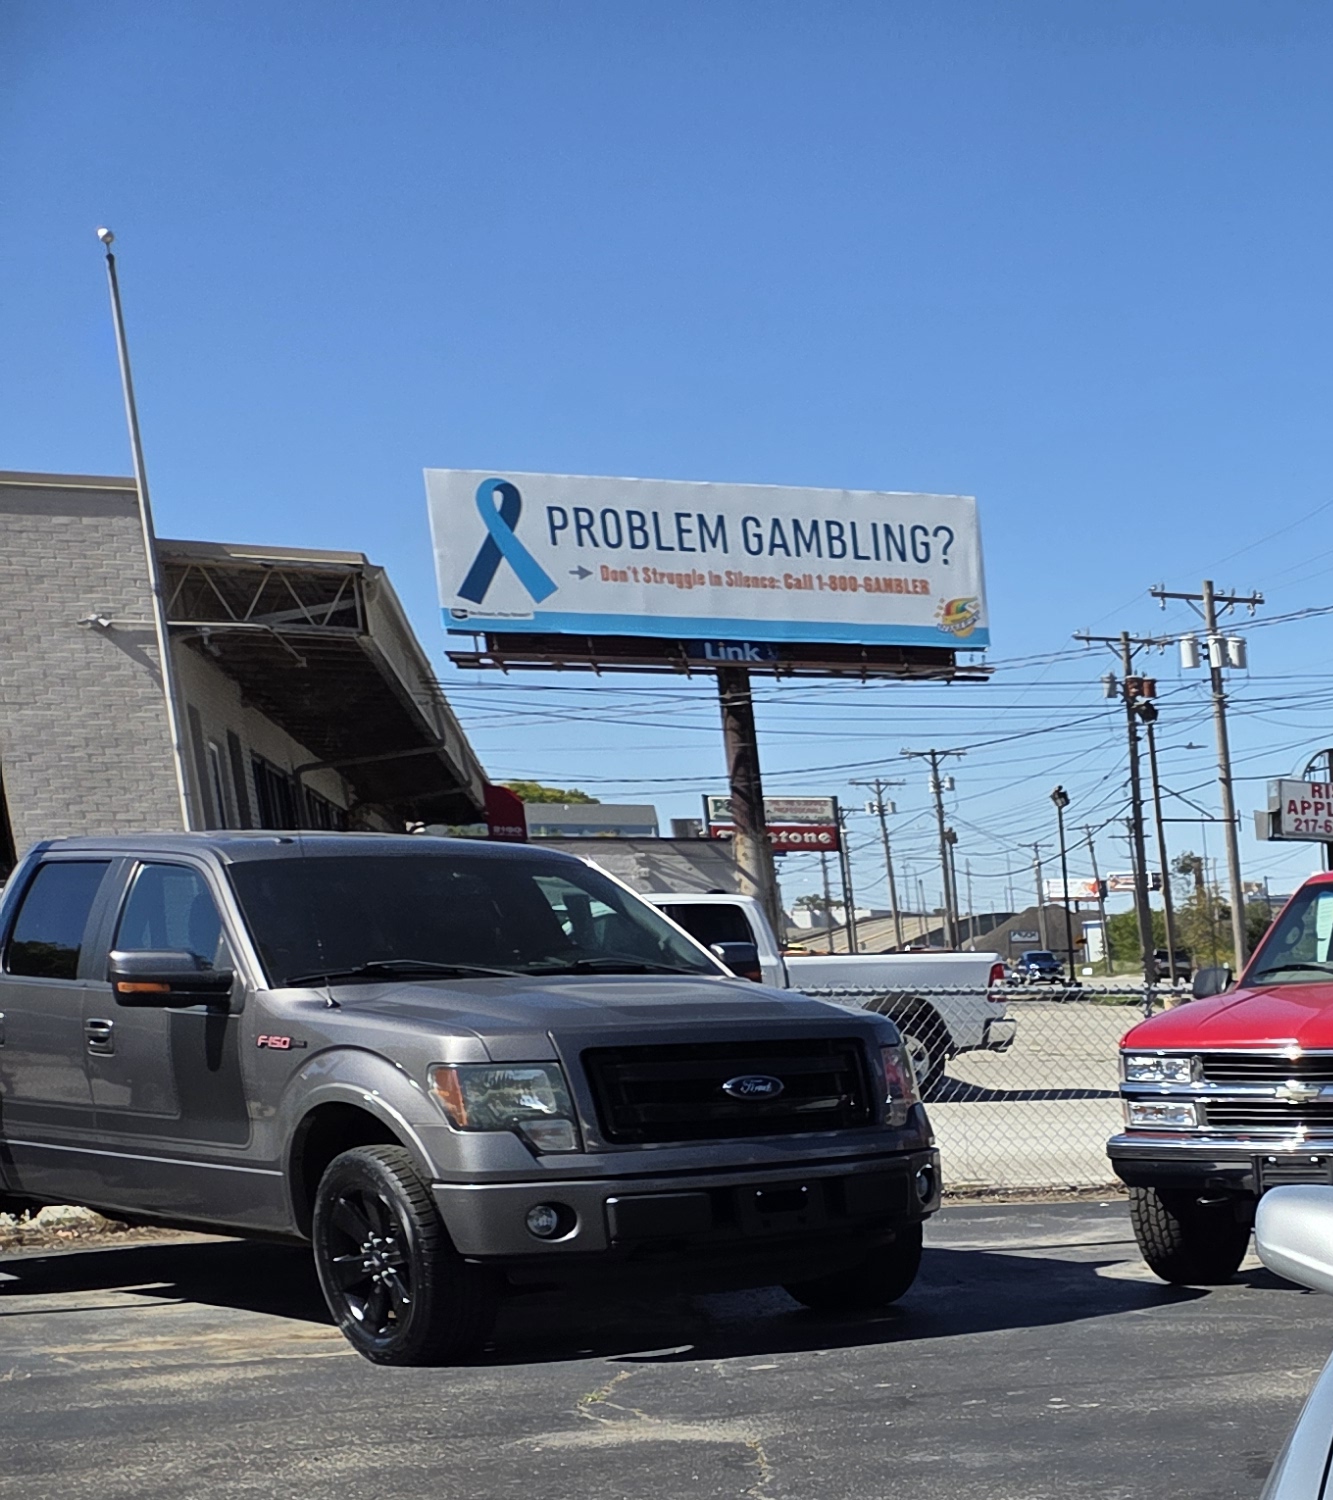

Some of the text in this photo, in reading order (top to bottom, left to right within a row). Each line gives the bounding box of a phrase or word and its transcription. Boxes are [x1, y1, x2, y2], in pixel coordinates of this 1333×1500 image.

[546, 505, 955, 566] PROBLEM GAMBLING?
[600, 564, 640, 584] Don't
[642, 566, 706, 590] Struggle
[783, 573, 814, 590] Call
[816, 573, 931, 596] 1-800-GAMBLER
[704, 641, 763, 662] Link
